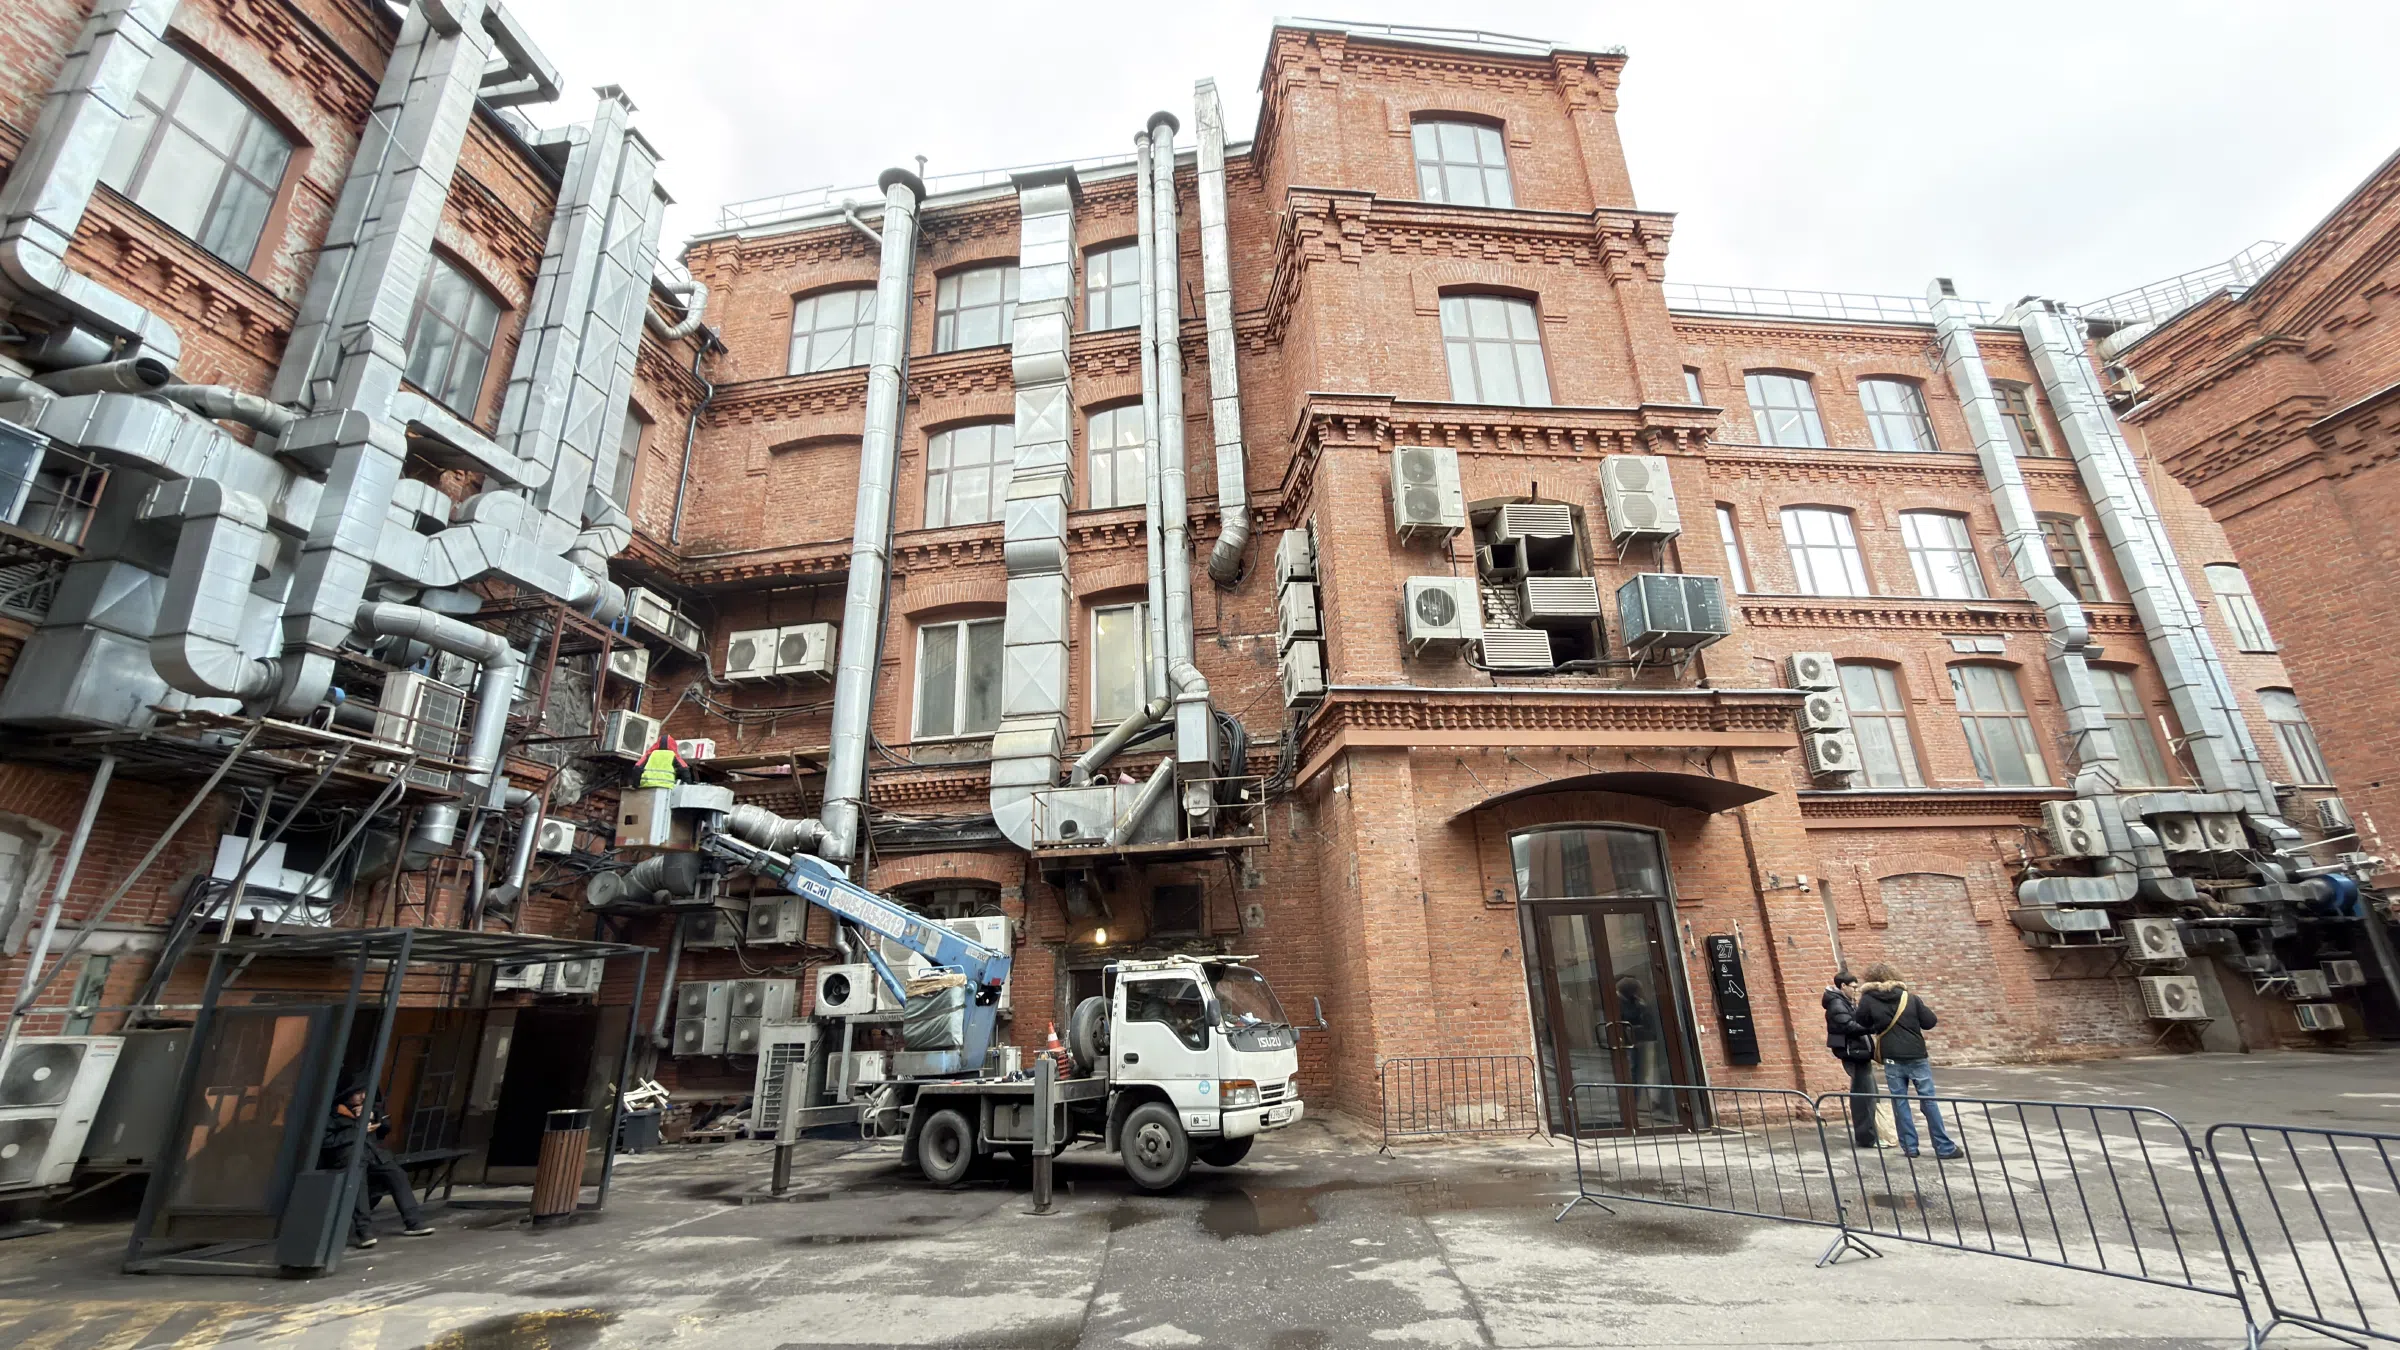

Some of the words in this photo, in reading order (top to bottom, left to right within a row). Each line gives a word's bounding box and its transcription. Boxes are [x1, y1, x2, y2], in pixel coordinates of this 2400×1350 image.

[803, 881, 828, 897] AICHI
[1717, 944, 1733, 958] 27
[1257, 1036, 1282, 1048] ISUZU
